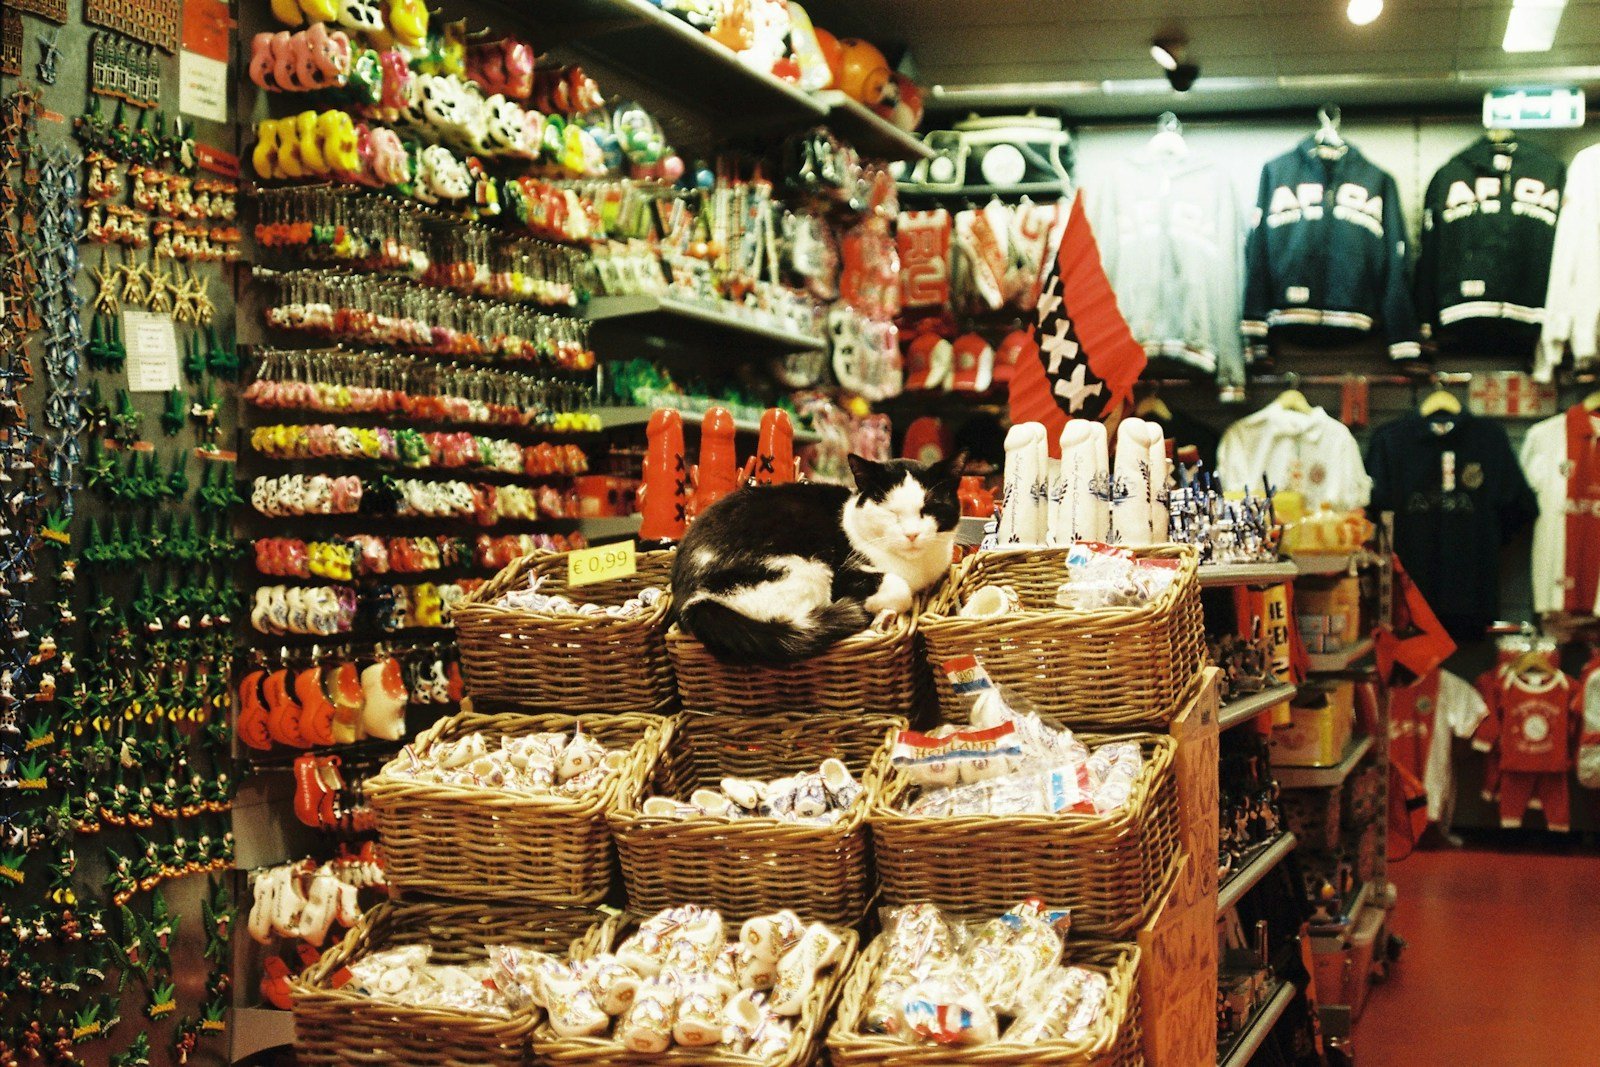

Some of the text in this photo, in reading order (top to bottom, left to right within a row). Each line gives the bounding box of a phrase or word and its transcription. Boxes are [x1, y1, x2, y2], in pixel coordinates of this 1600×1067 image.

[573, 550, 627, 575] € 0,99
[916, 741, 997, 761] HOLLAND
